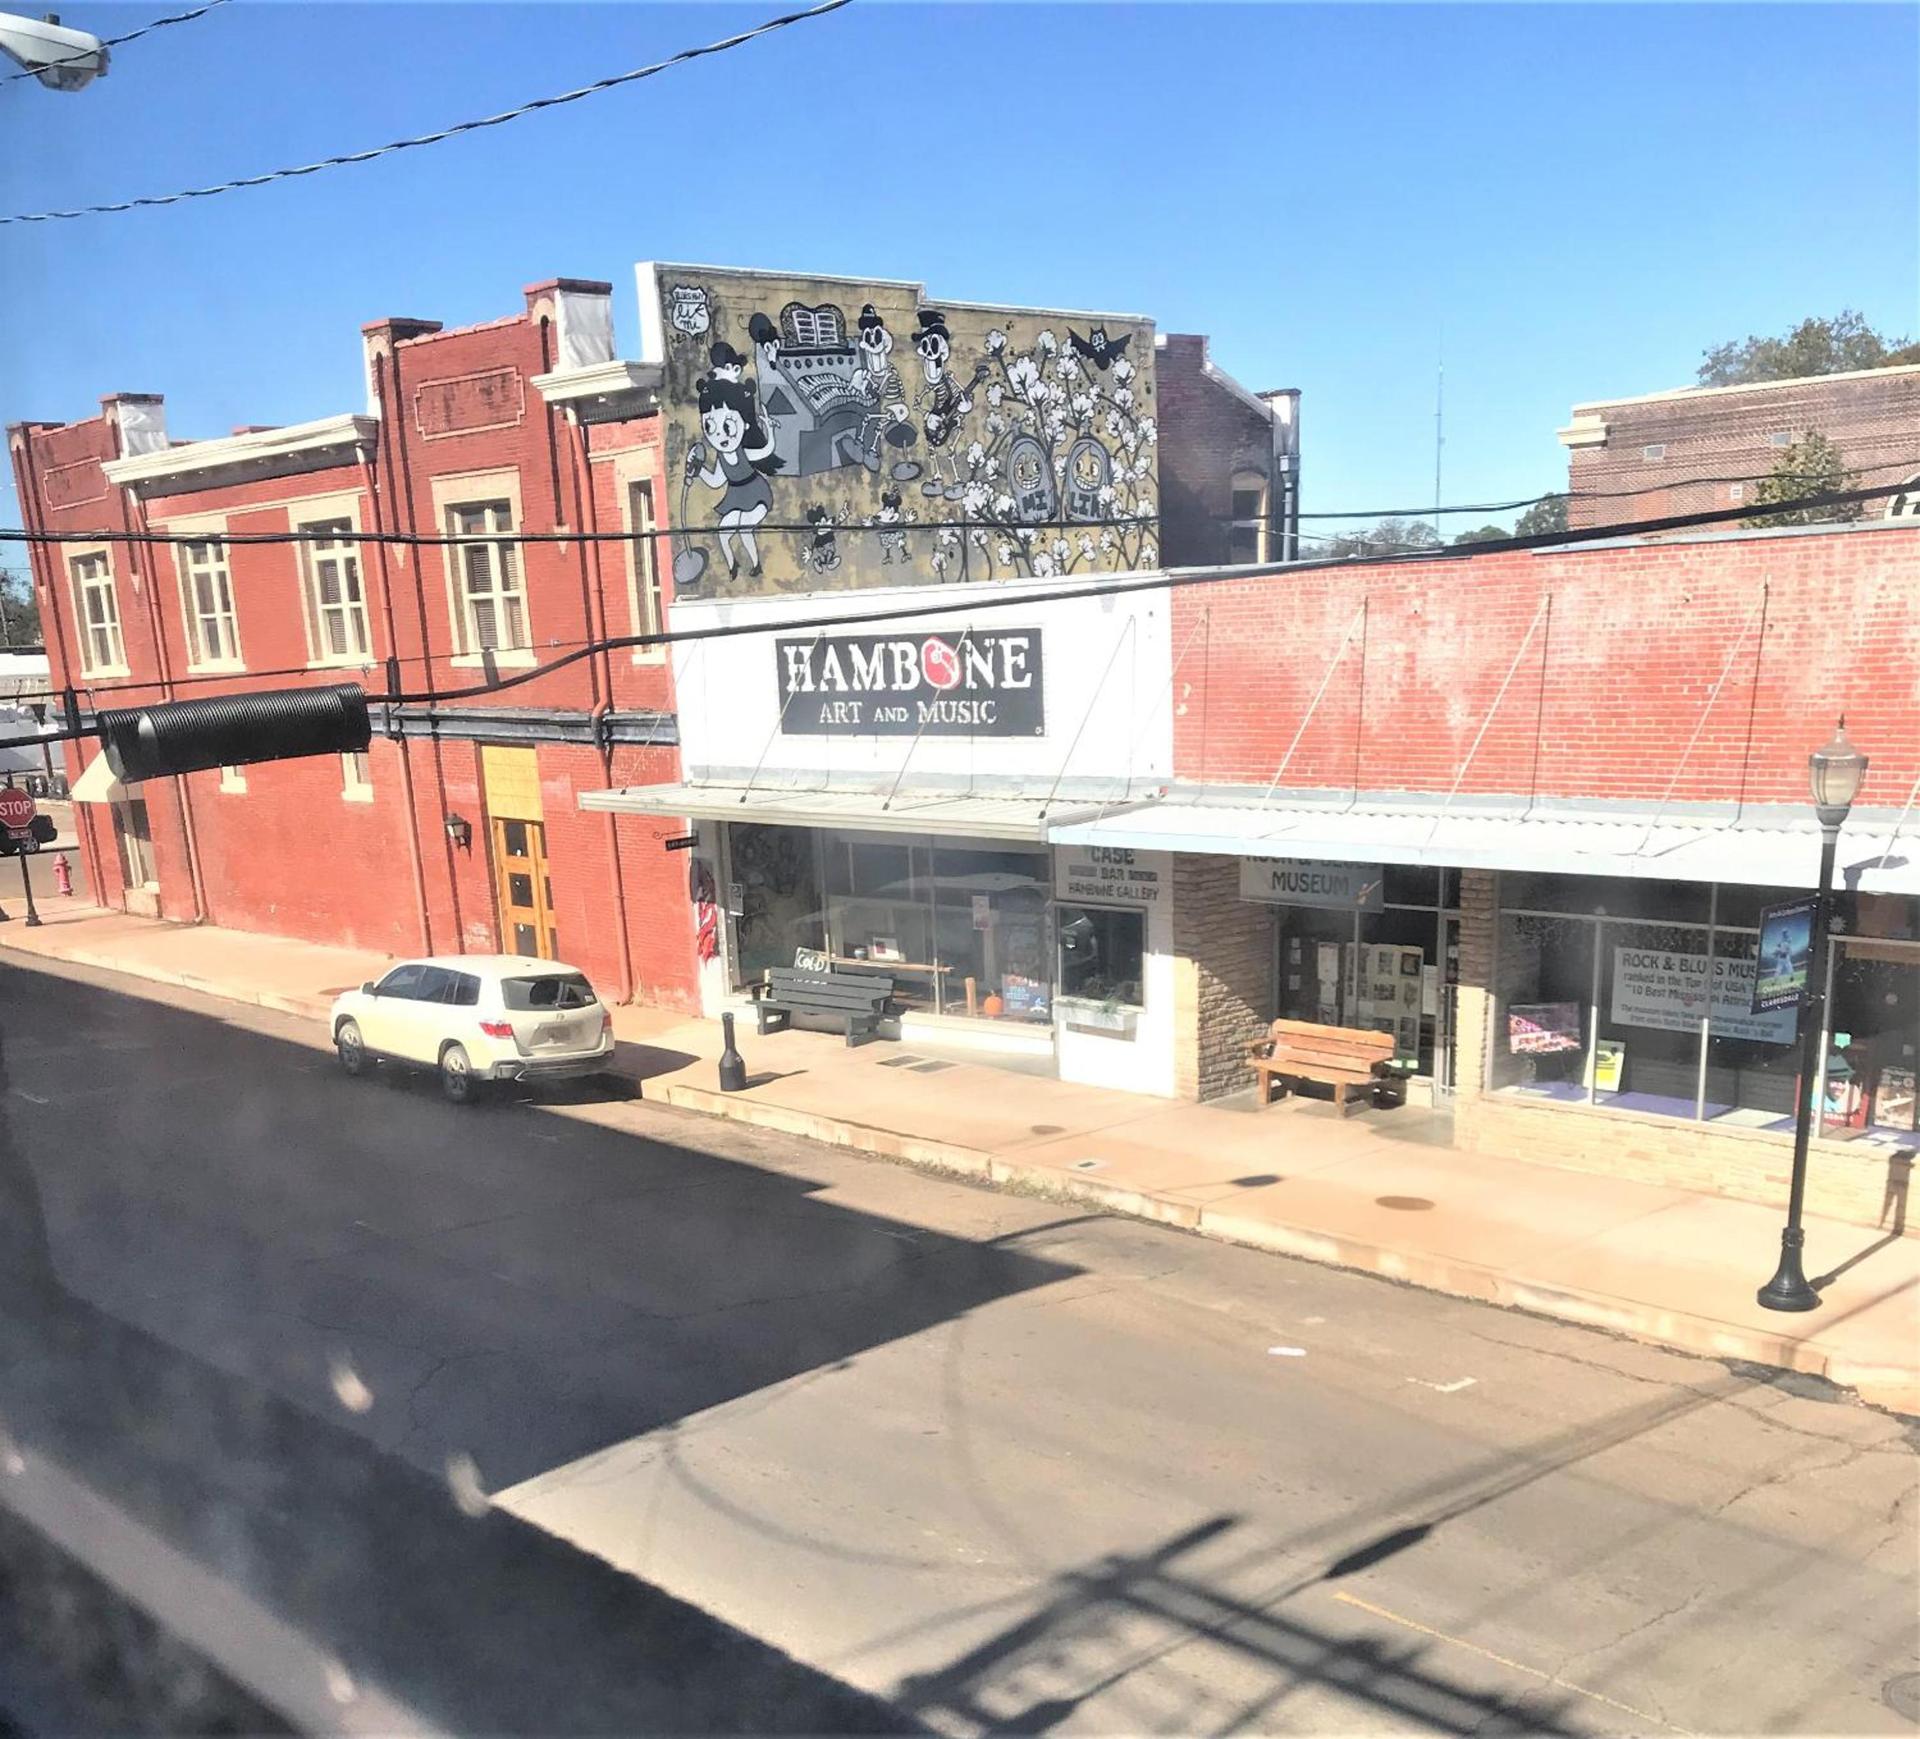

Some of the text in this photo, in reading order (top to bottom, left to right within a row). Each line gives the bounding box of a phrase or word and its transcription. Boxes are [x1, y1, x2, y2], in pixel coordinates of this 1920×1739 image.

[782, 637, 1034, 693] HAMBONE
[819, 699, 998, 725] ART AND MUSIC
[0, 801, 31, 816] STOP
[1100, 867, 1125, 881] BAR
[1271, 871, 1350, 896] MUSEUM
[1622, 953, 1756, 980] ROCK & BLUS MUS
